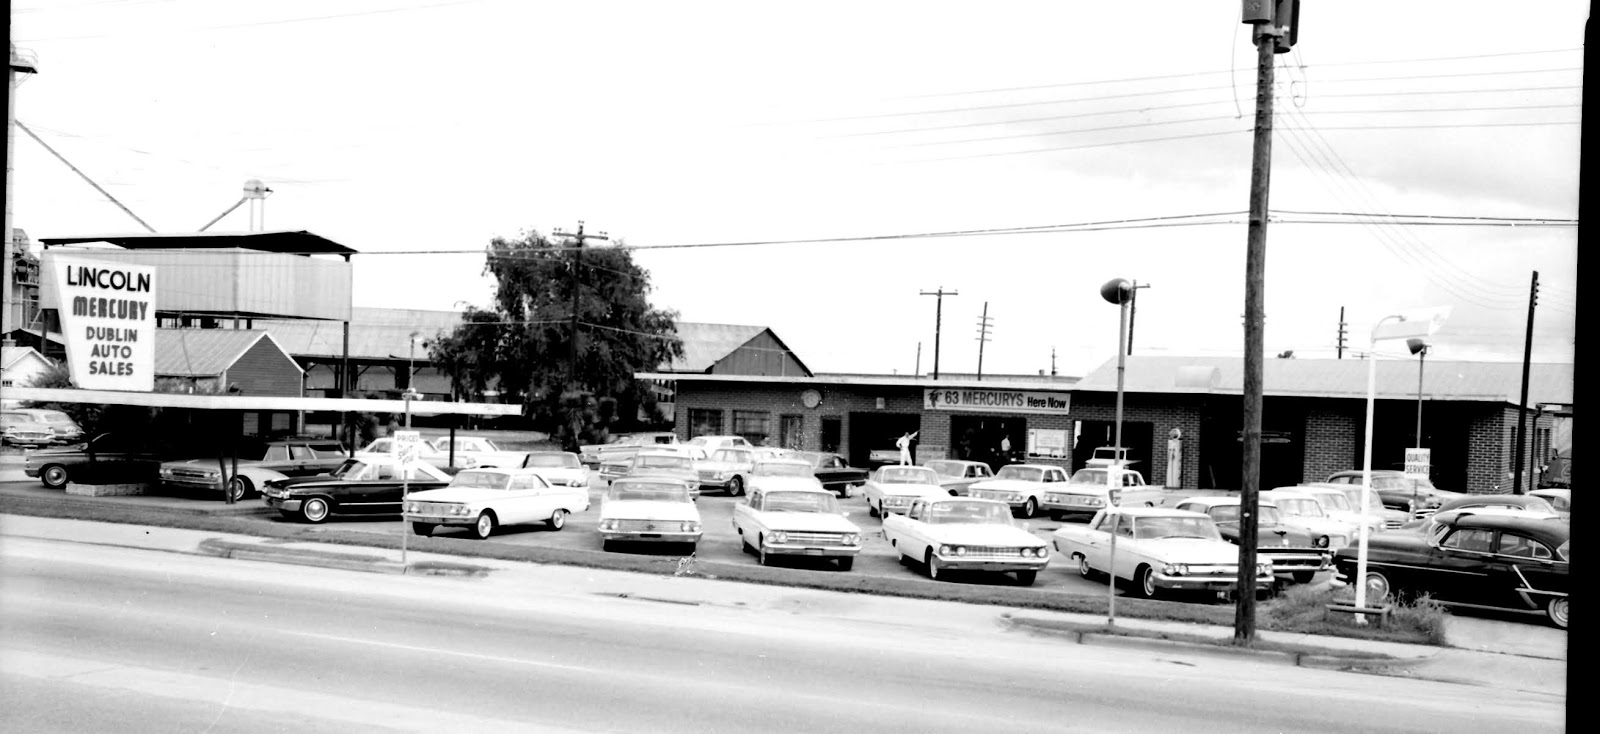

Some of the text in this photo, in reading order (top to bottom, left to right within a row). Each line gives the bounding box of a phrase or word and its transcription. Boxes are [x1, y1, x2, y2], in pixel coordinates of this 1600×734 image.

[67, 265, 150, 293] LINCOLN
[73, 296, 148, 321] MERCURY
[86, 326, 137, 342] DUBLIN
[91, 344, 132, 359] AUTO
[89, 361, 133, 376] SALES
[944, 391, 1067, 409] 63 MERCURYS Here Now
[1407, 453, 1430, 462] QUALITY
[1406, 464, 1429, 475] SERVICE
